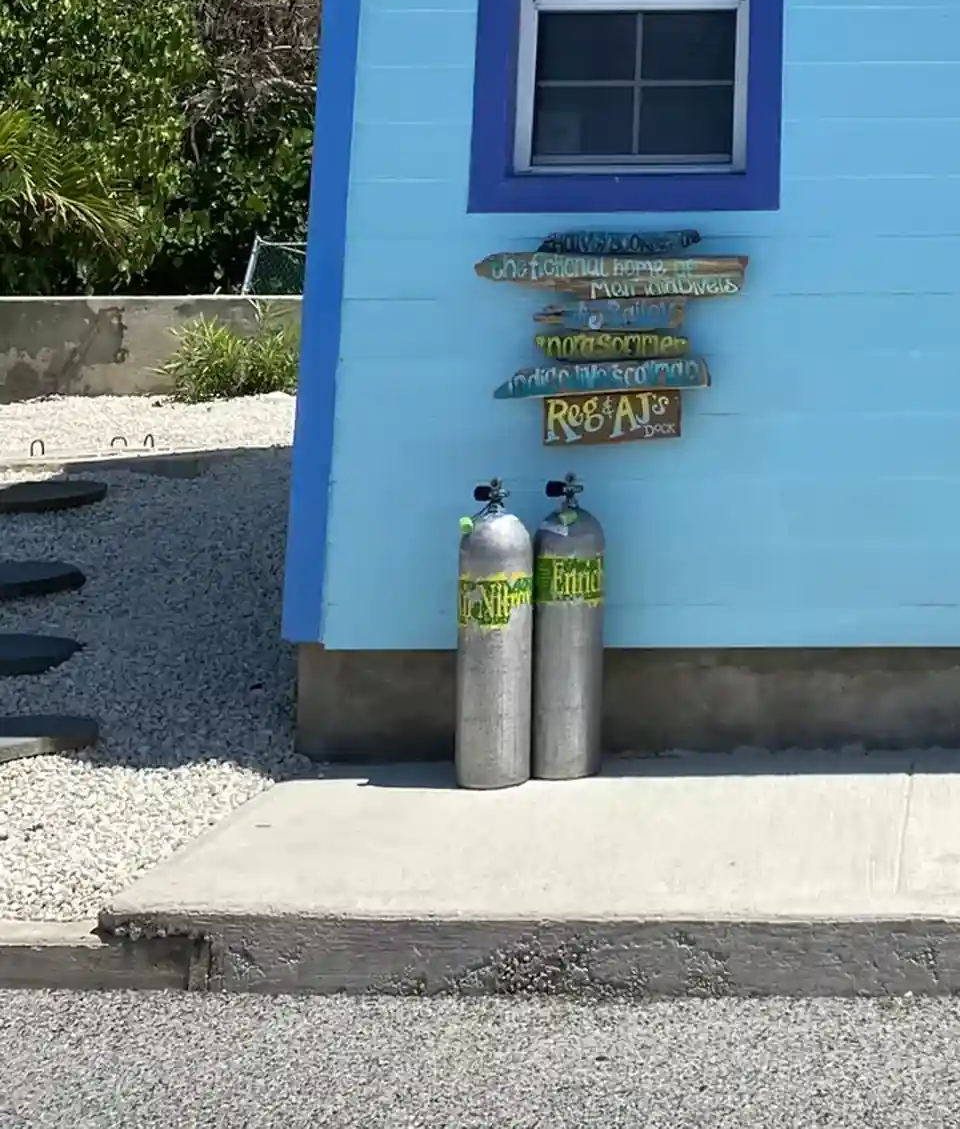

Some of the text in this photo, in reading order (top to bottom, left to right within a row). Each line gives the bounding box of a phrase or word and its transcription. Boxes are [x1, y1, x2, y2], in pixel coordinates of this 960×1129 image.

[545, 391, 670, 443] Reg & AJ's
